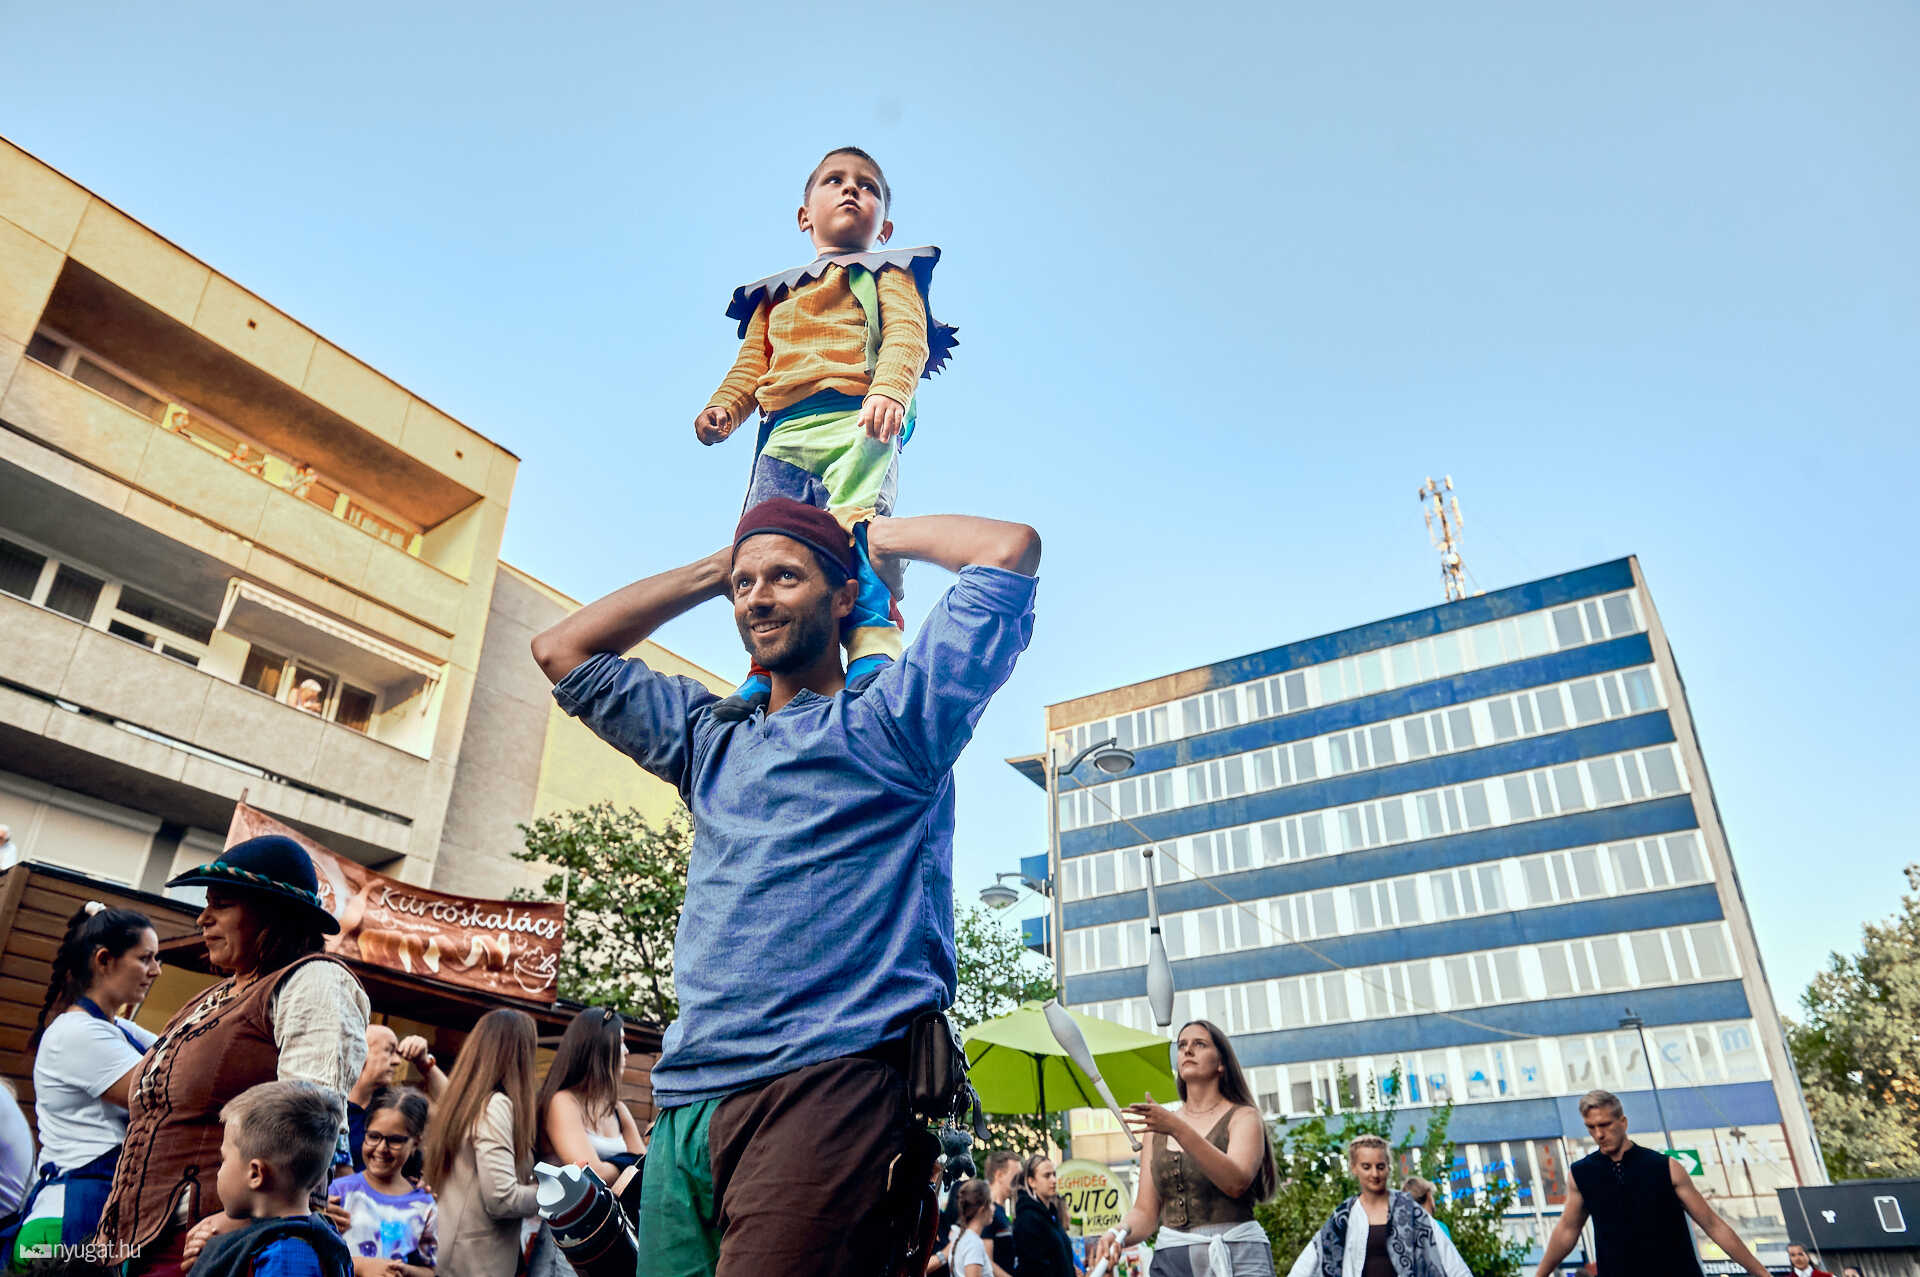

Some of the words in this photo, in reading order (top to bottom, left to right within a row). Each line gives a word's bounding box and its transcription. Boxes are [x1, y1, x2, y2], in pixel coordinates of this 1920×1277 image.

[379, 886, 562, 940] Kürtőskalács
[1062, 1188, 1119, 1213] OJITO
[1087, 1213, 1122, 1226] VIRGIN
